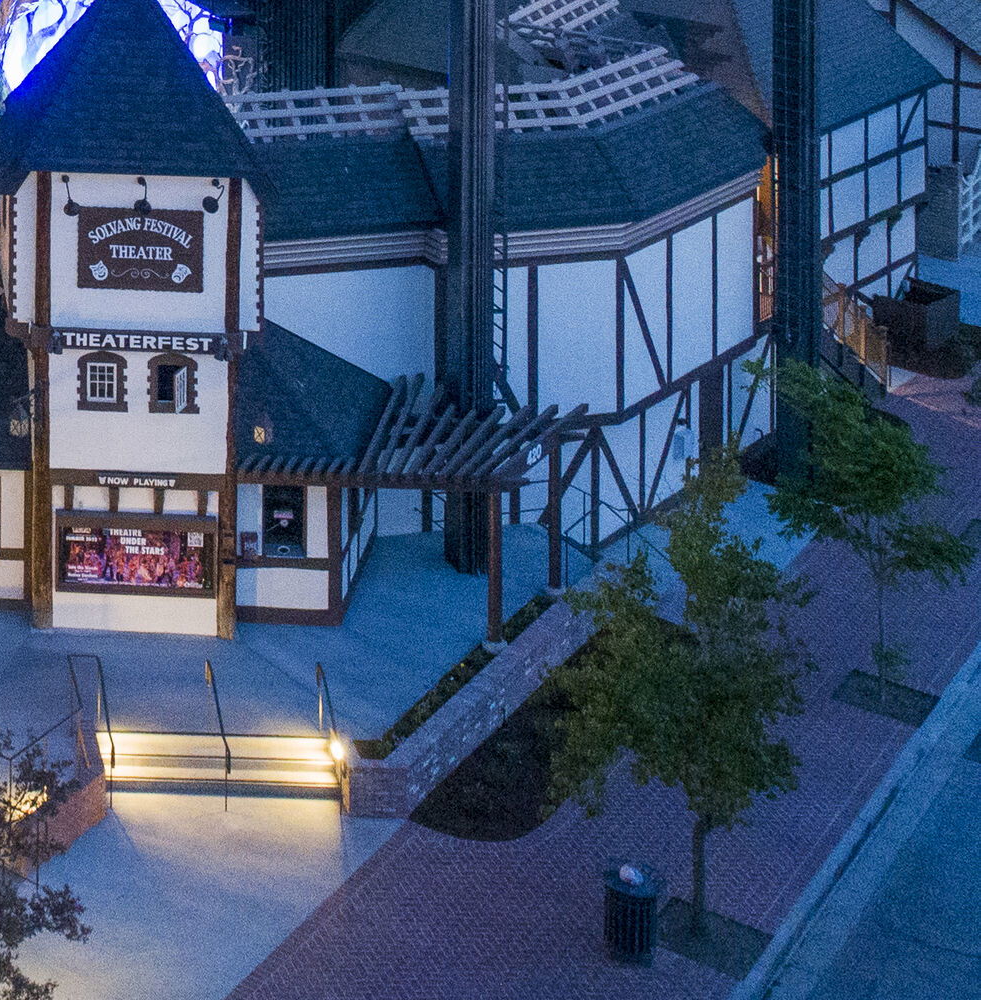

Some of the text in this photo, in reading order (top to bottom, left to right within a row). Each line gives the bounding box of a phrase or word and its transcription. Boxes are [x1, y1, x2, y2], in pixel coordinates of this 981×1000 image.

[88, 217, 193, 249] SOLVANG FESTIVAL
[109, 244, 173, 261] THEATER
[64, 332, 212, 351] THEATERFEST
[107, 476, 168, 487] NOW PLAYING
[120, 537, 147, 546] UNDER
[125, 546, 165, 556] THE STARS
